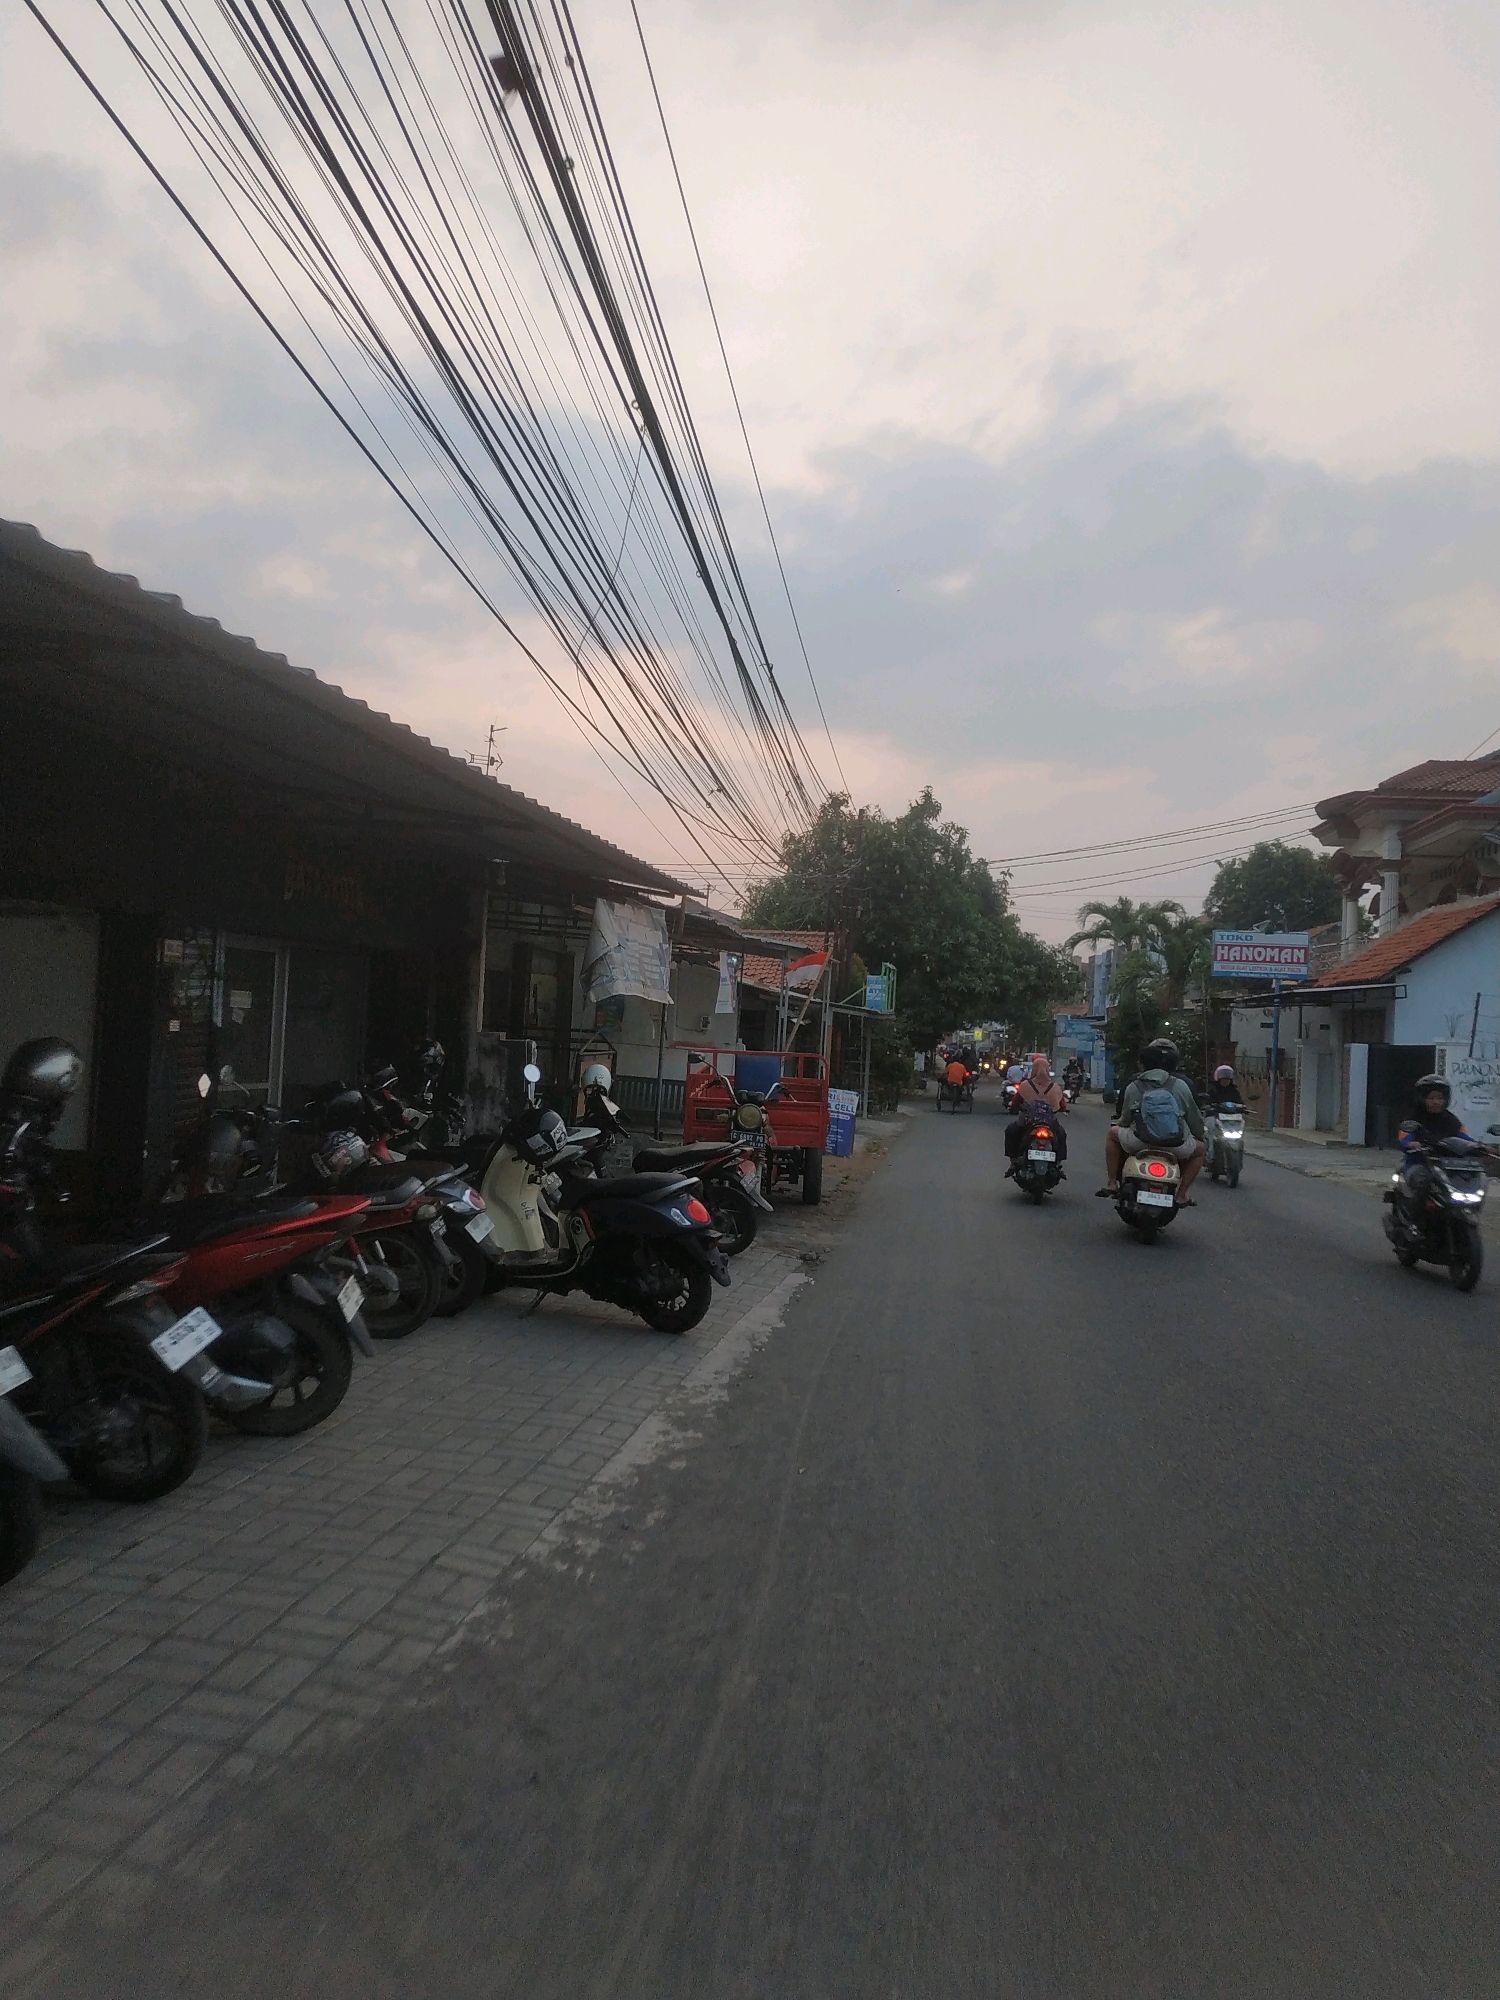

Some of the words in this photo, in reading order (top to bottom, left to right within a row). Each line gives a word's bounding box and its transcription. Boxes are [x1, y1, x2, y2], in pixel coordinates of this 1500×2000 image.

[1219, 934, 1253, 942] TOKO
[1216, 945, 1305, 963] HANOMAN
[834, 1103, 855, 1114] CELL
